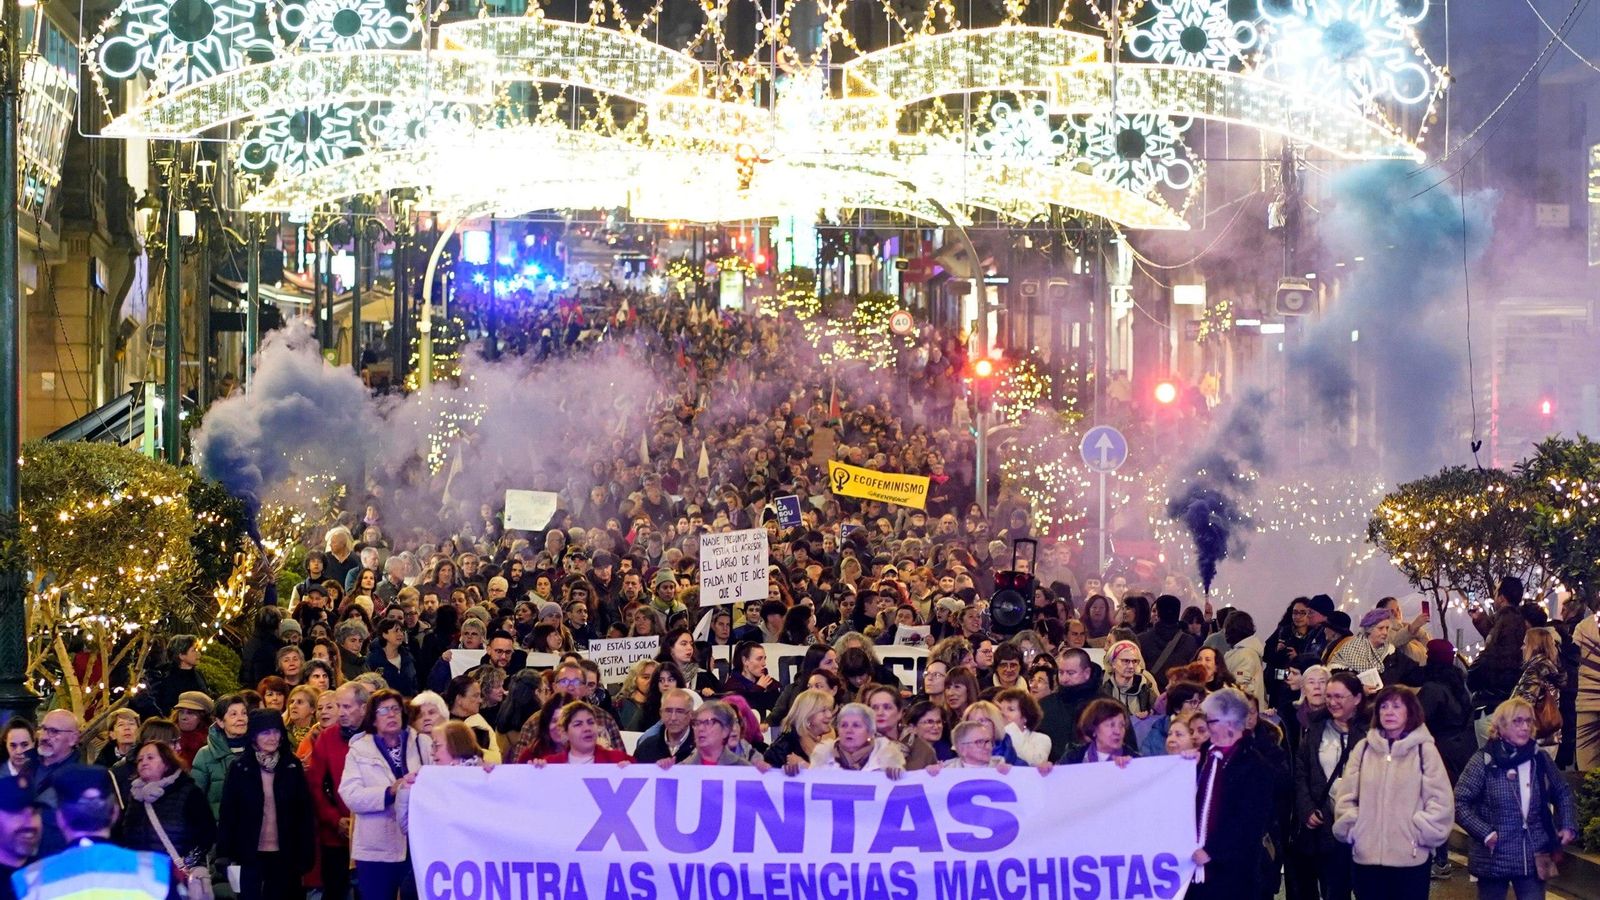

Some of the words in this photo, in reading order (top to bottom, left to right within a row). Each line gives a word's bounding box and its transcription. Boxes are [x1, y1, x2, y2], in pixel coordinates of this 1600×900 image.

[895, 318, 908, 326] 40
[853, 474, 925, 495] ECOFEMINISMO
[866, 490, 911, 503] GREENPEACE
[777, 504, 788, 512] CA
[702, 537, 720, 546] NADIE
[702, 560, 713, 572] EL
[715, 557, 738, 570] LARGO
[741, 555, 749, 566] DE
[703, 575, 725, 588] FALDA
[727, 572, 738, 584] NO
[740, 571, 749, 582] TE
[718, 587, 730, 599] QUE
[591, 643, 602, 652] NO
[634, 640, 657, 650] SOLAS
[594, 655, 624, 665] VUESTRA
[575, 777, 1020, 853] XUNTAS
[425, 860, 588, 900] CONTRA
[606, 861, 657, 900] AS
[669, 860, 918, 900] VIOLENCIAS
[933, 852, 1181, 900] MACHISTAS
